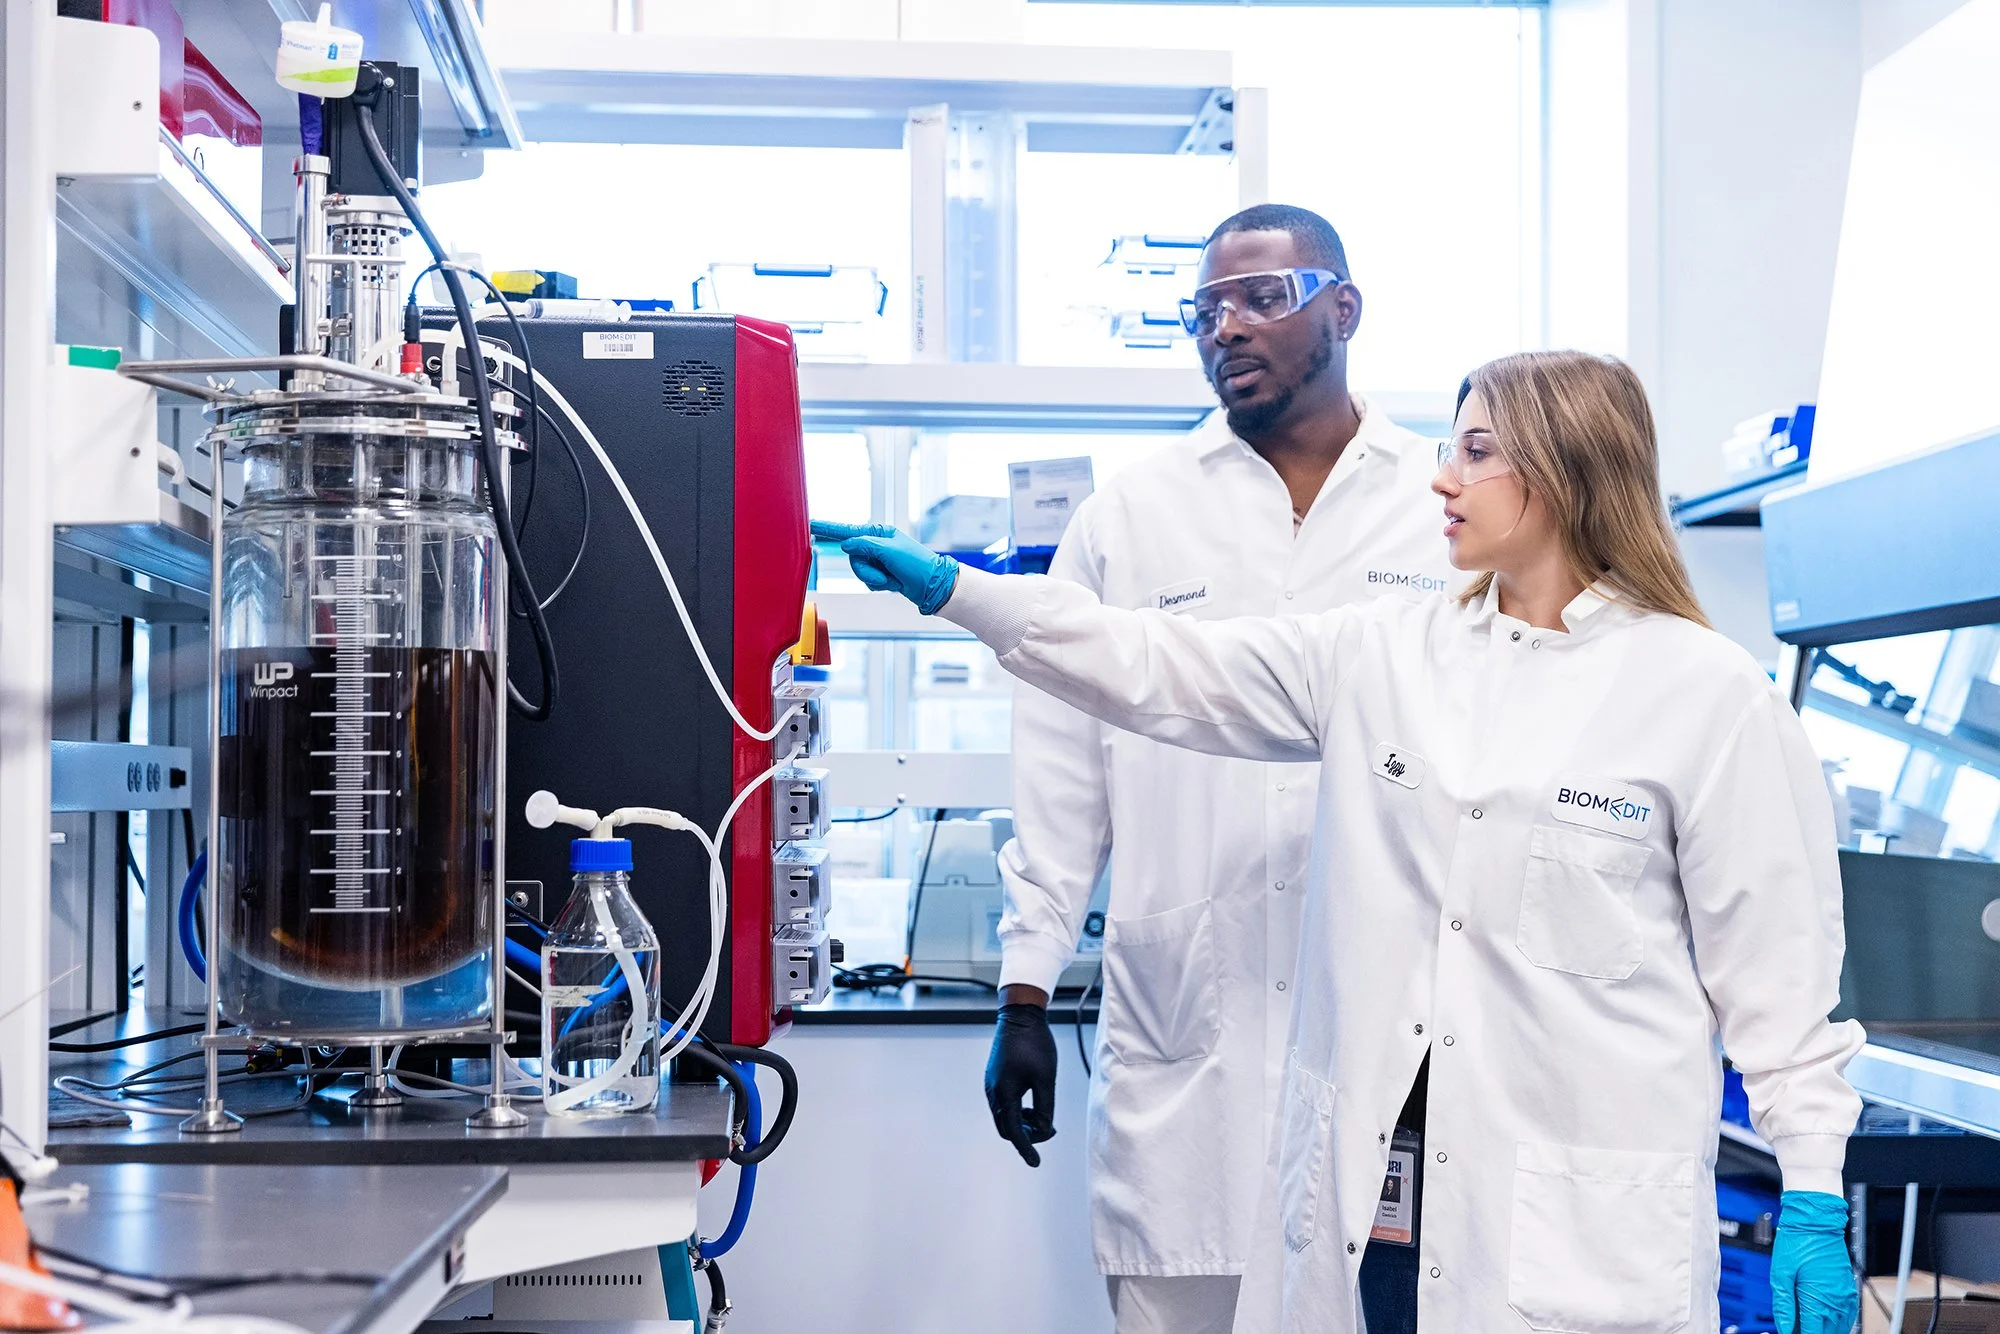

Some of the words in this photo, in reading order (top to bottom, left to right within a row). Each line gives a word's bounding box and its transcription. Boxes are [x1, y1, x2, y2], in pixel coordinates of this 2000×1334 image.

[393, 553, 403, 561] 10
[1159, 585, 1206, 608] Desmond
[254, 661, 294, 686] WP
[396, 671, 402, 679] 7
[250, 684, 299, 700] Winpact
[396, 711, 402, 720] 6
[1383, 753, 1406, 778] Iggy
[396, 789, 402, 797] 4
[396, 827, 402, 836] 3
[396, 866, 402, 875] 2
